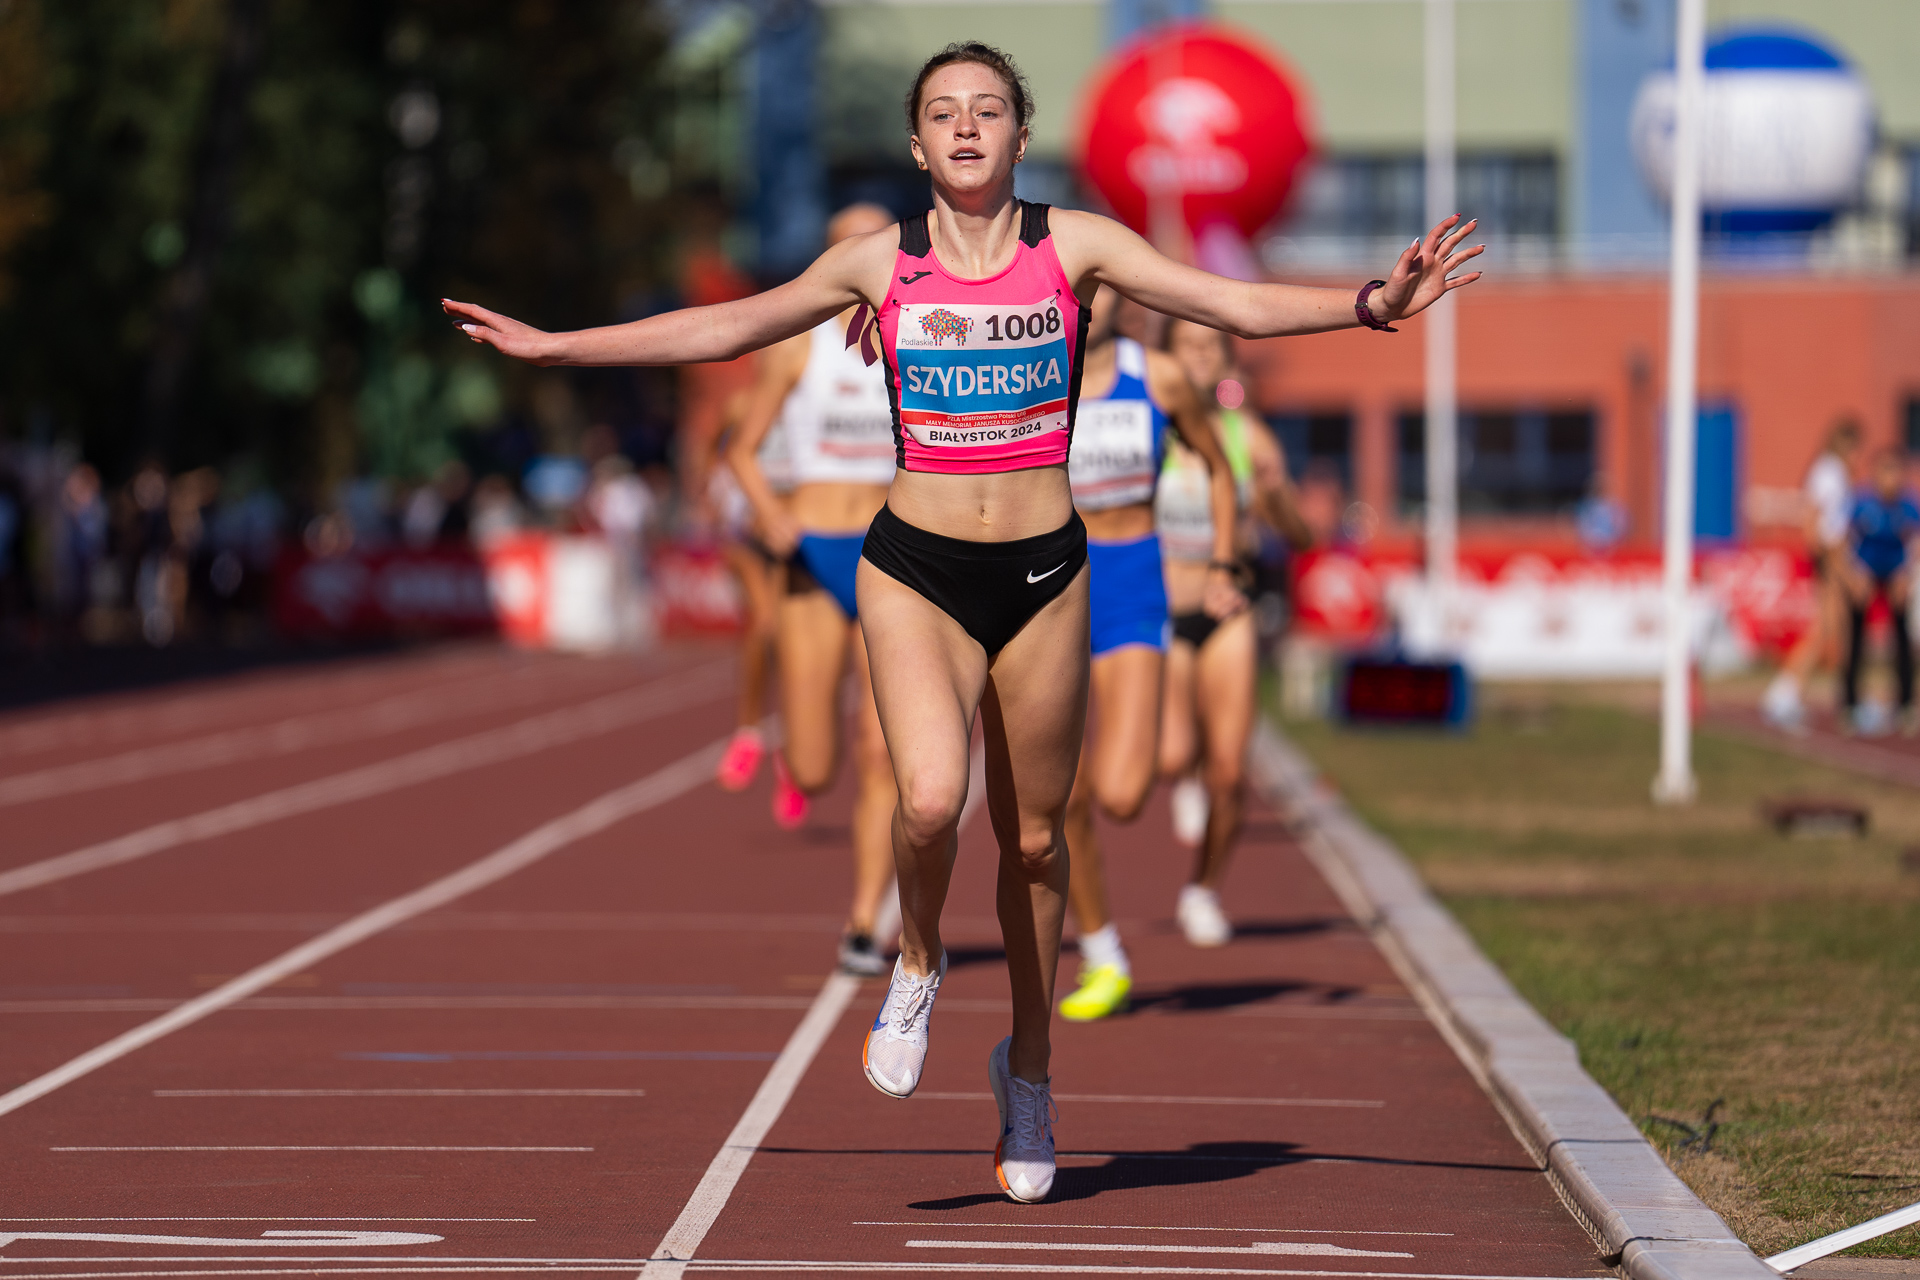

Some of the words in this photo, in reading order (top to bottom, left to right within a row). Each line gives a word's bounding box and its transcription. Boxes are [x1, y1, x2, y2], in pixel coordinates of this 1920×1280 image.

[985, 306, 1061, 342] 1008
[901, 338, 934, 347] Podlaskie
[906, 357, 1062, 398] SZYDERSKA
[961, 414, 997, 422] Mistrzostwa
[973, 419, 1000, 428] JANUSZA
[929, 429, 1007, 442] BIAŁYSTOK
[1010, 421, 1042, 438] 2024
